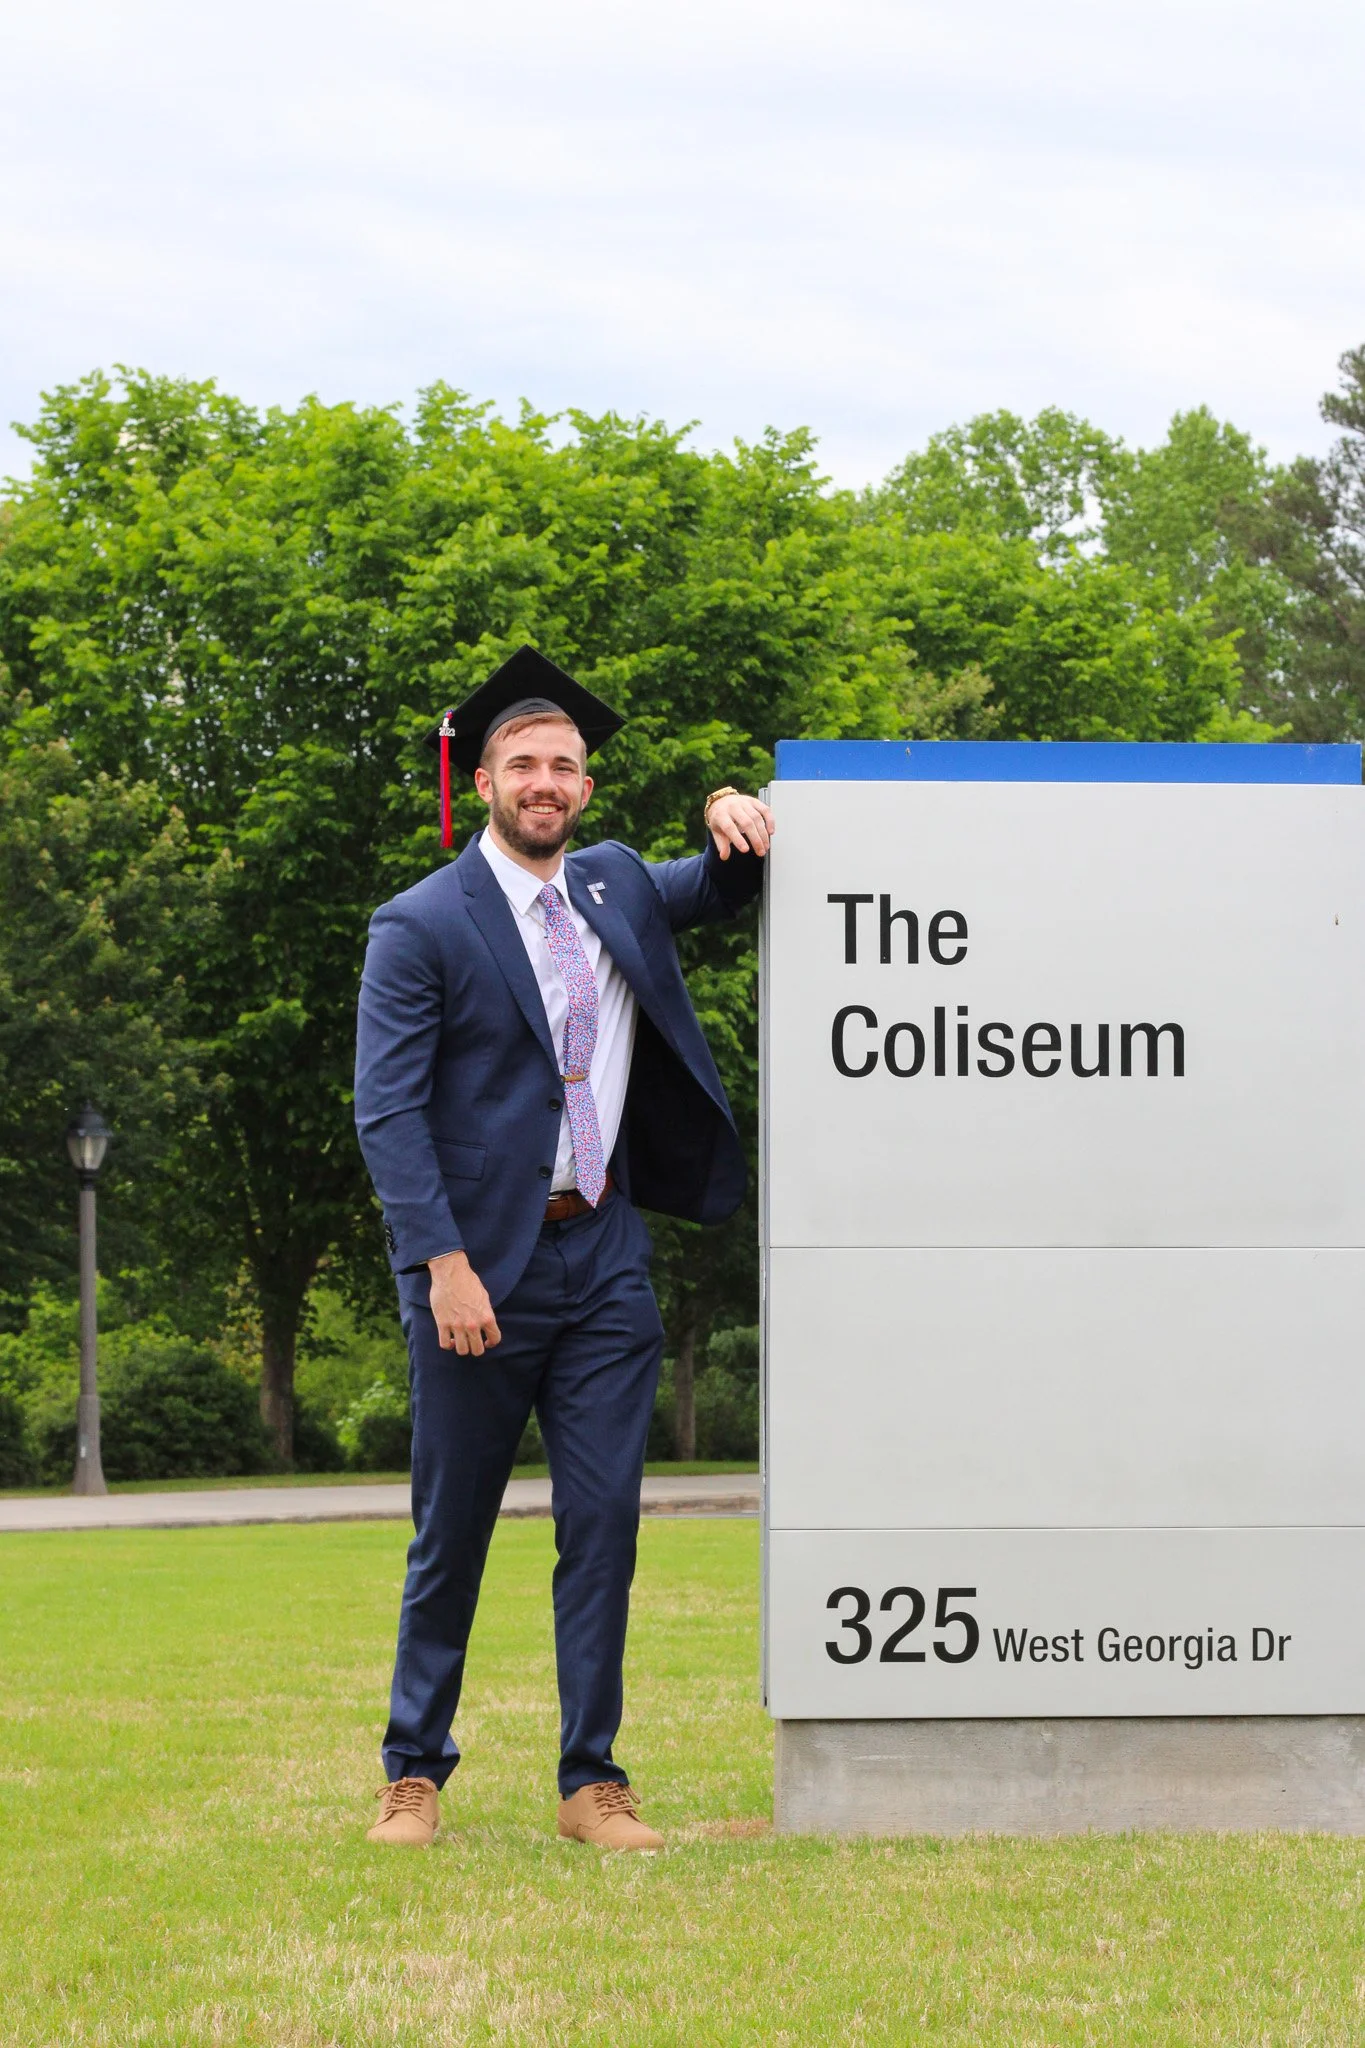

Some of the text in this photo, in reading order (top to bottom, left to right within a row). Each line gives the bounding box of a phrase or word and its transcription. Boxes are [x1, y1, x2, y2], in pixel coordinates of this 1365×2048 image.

[827, 893, 969, 966] The
[831, 1004, 1186, 1078] Coliseum
[825, 1586, 1293, 1670] 325 West Georgia Dr
